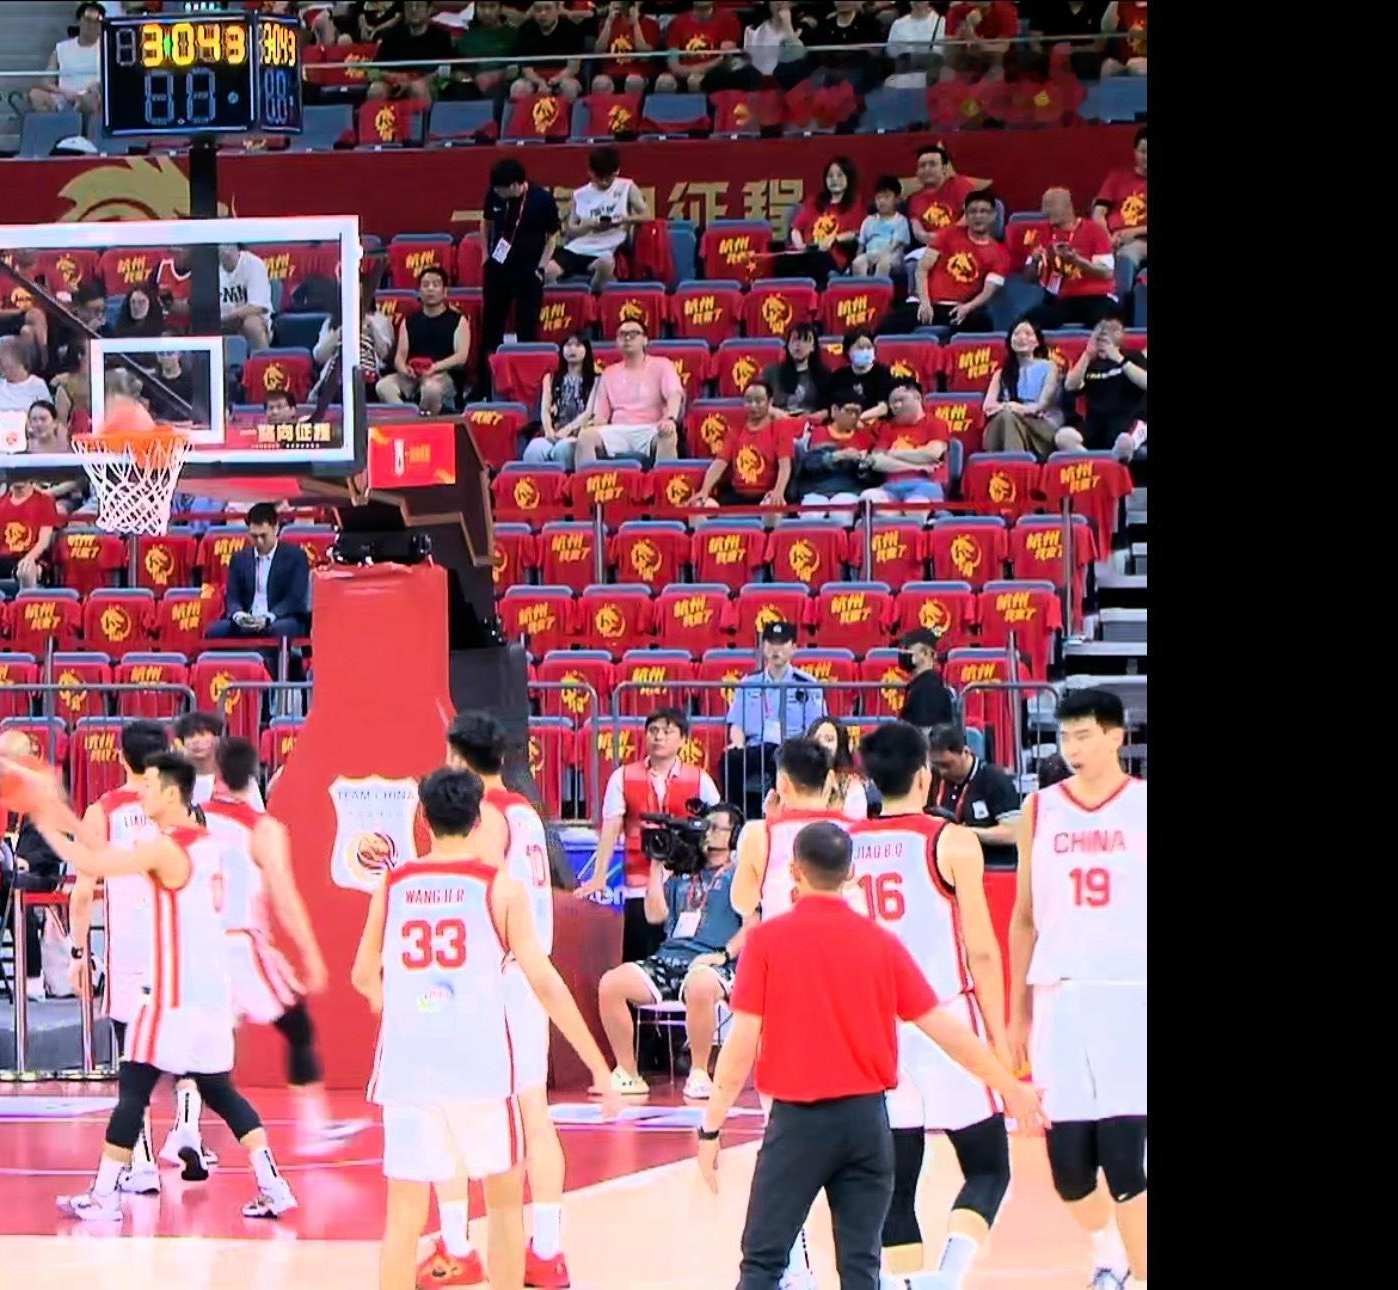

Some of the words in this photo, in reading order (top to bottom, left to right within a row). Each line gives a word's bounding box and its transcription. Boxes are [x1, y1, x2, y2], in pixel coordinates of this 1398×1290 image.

[1054, 830, 1126, 855] CHINA
[858, 873, 905, 921] 16
[1069, 867, 1110, 907] 19
[402, 919, 467, 969] 33
